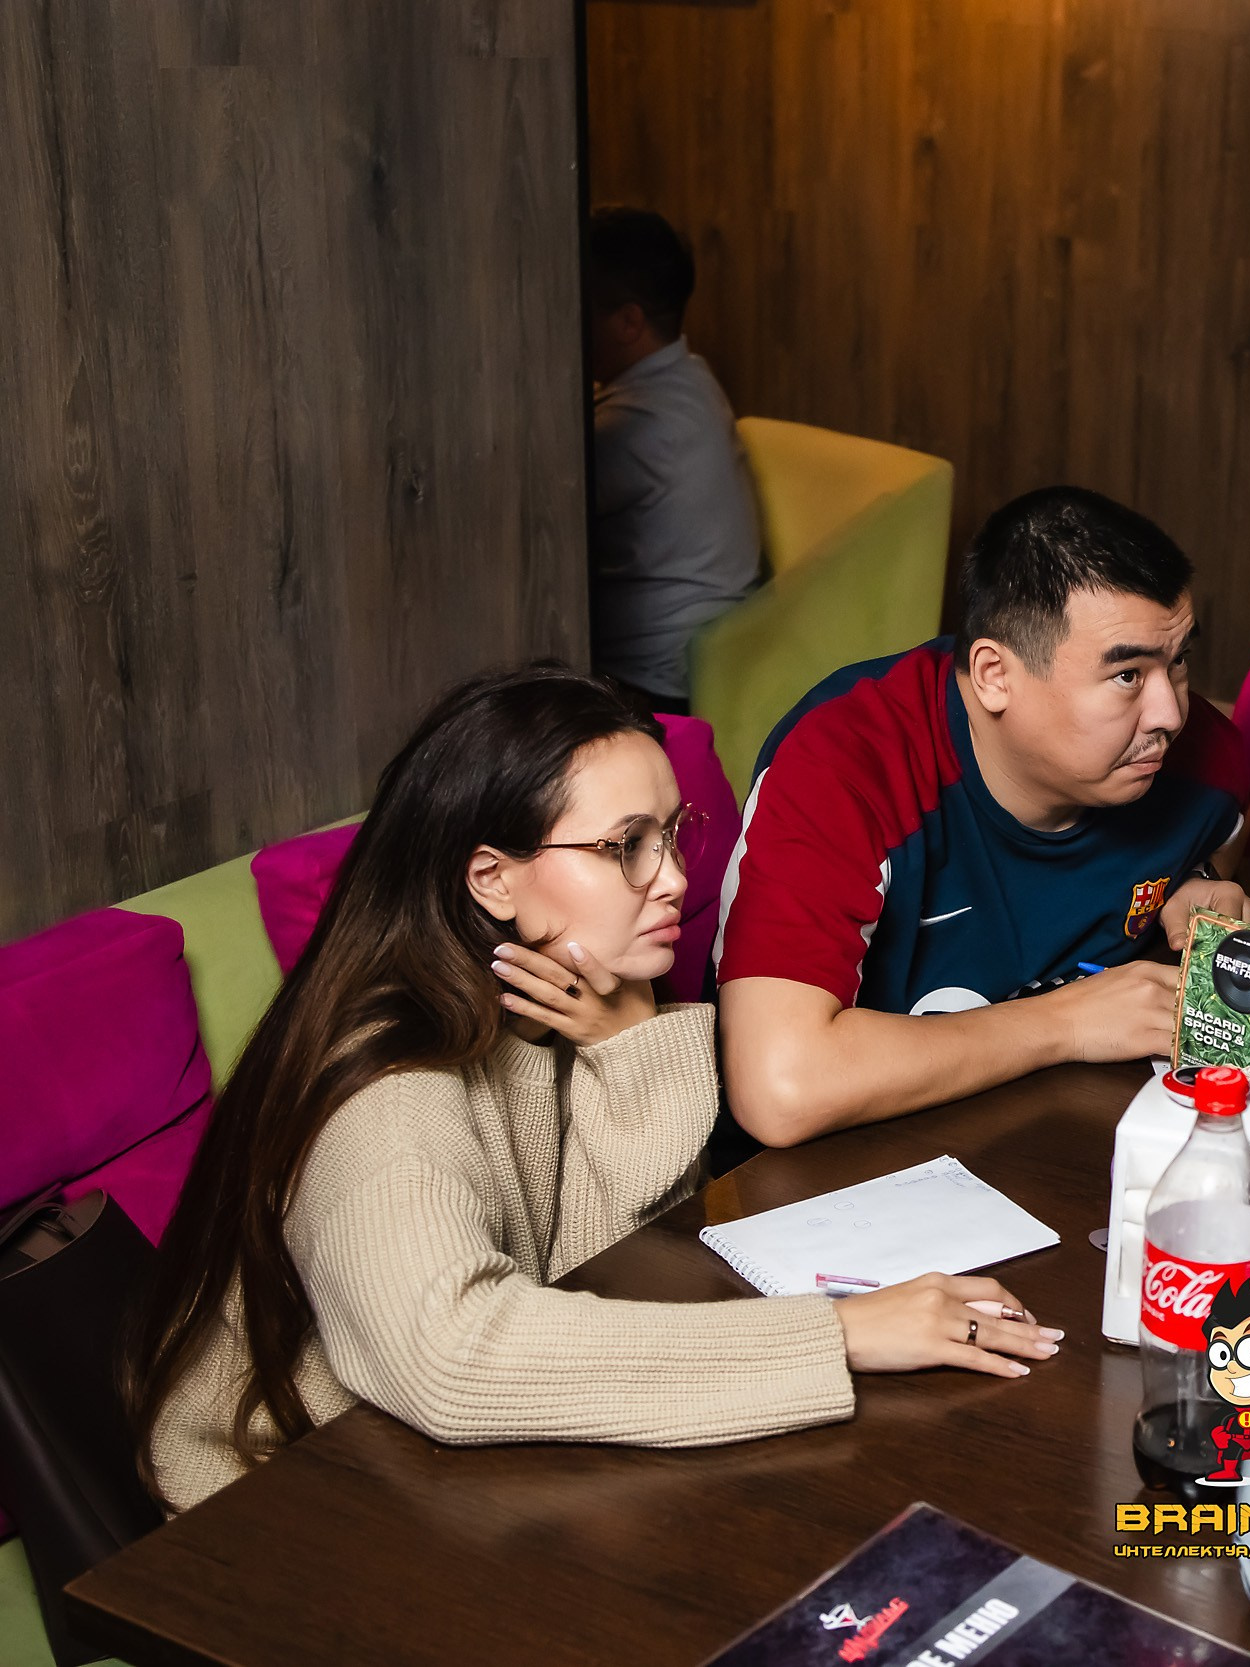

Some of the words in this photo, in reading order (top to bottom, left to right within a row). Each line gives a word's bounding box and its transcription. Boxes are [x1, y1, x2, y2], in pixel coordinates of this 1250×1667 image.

[1215, 960, 1238, 975] ТАМ,
[1183, 1016, 1232, 1041] SPICED
[1234, 1036, 1245, 1047] &
[1194, 1031, 1231, 1053] COLA
[934, 1598, 1019, 1660] МЕНЮ
